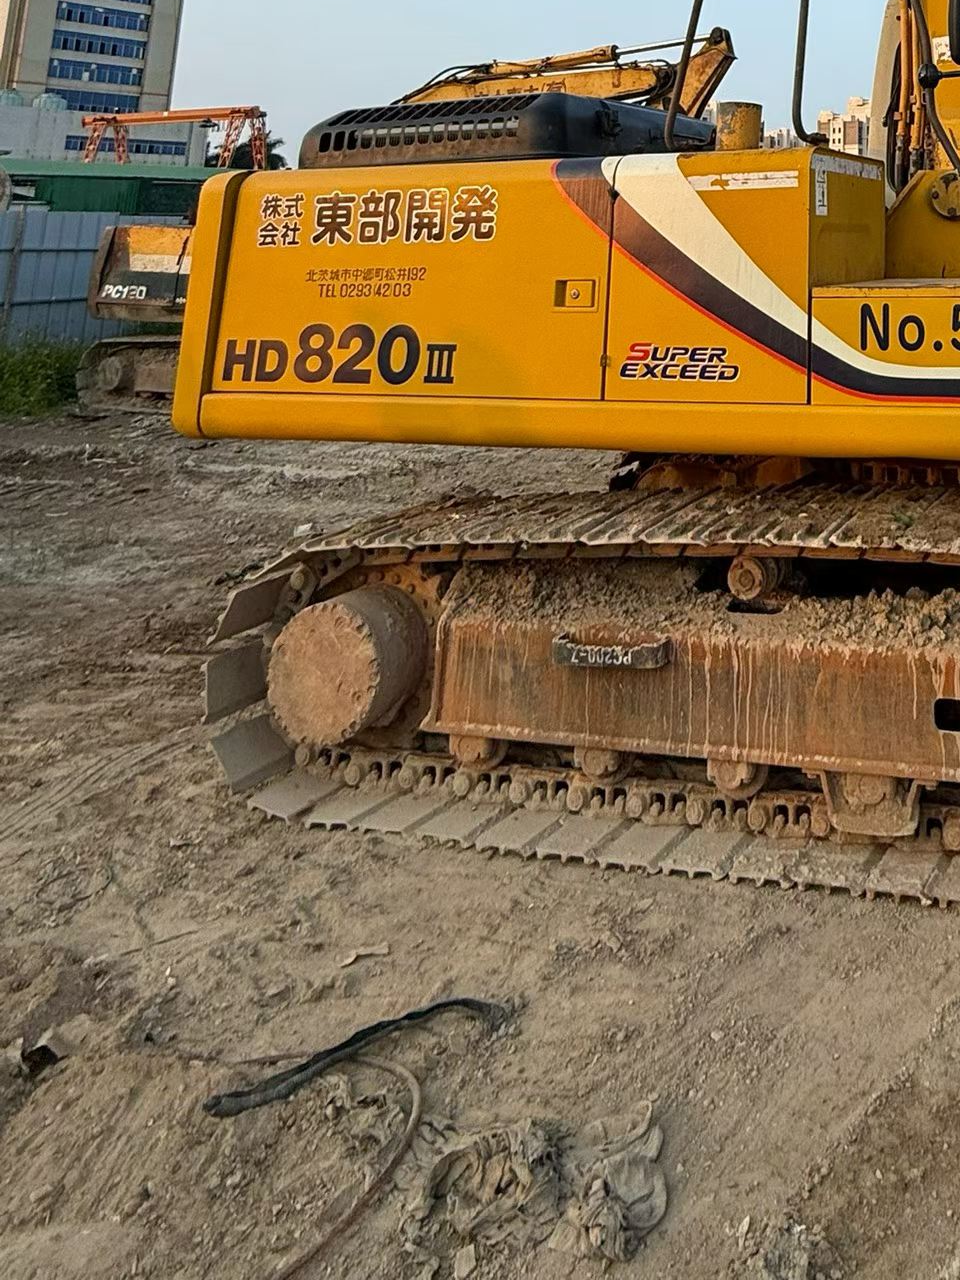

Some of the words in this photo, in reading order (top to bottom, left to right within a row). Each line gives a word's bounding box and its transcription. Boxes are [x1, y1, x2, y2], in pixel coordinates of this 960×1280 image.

[261, 194, 305, 219] 株式
[311, 185, 498, 245] 東部開発
[257, 221, 301, 246] 会社
[318, 283, 337, 298] TEL
[625, 341, 728, 363] SUPER
[619, 362, 739, 381] EXCEED
